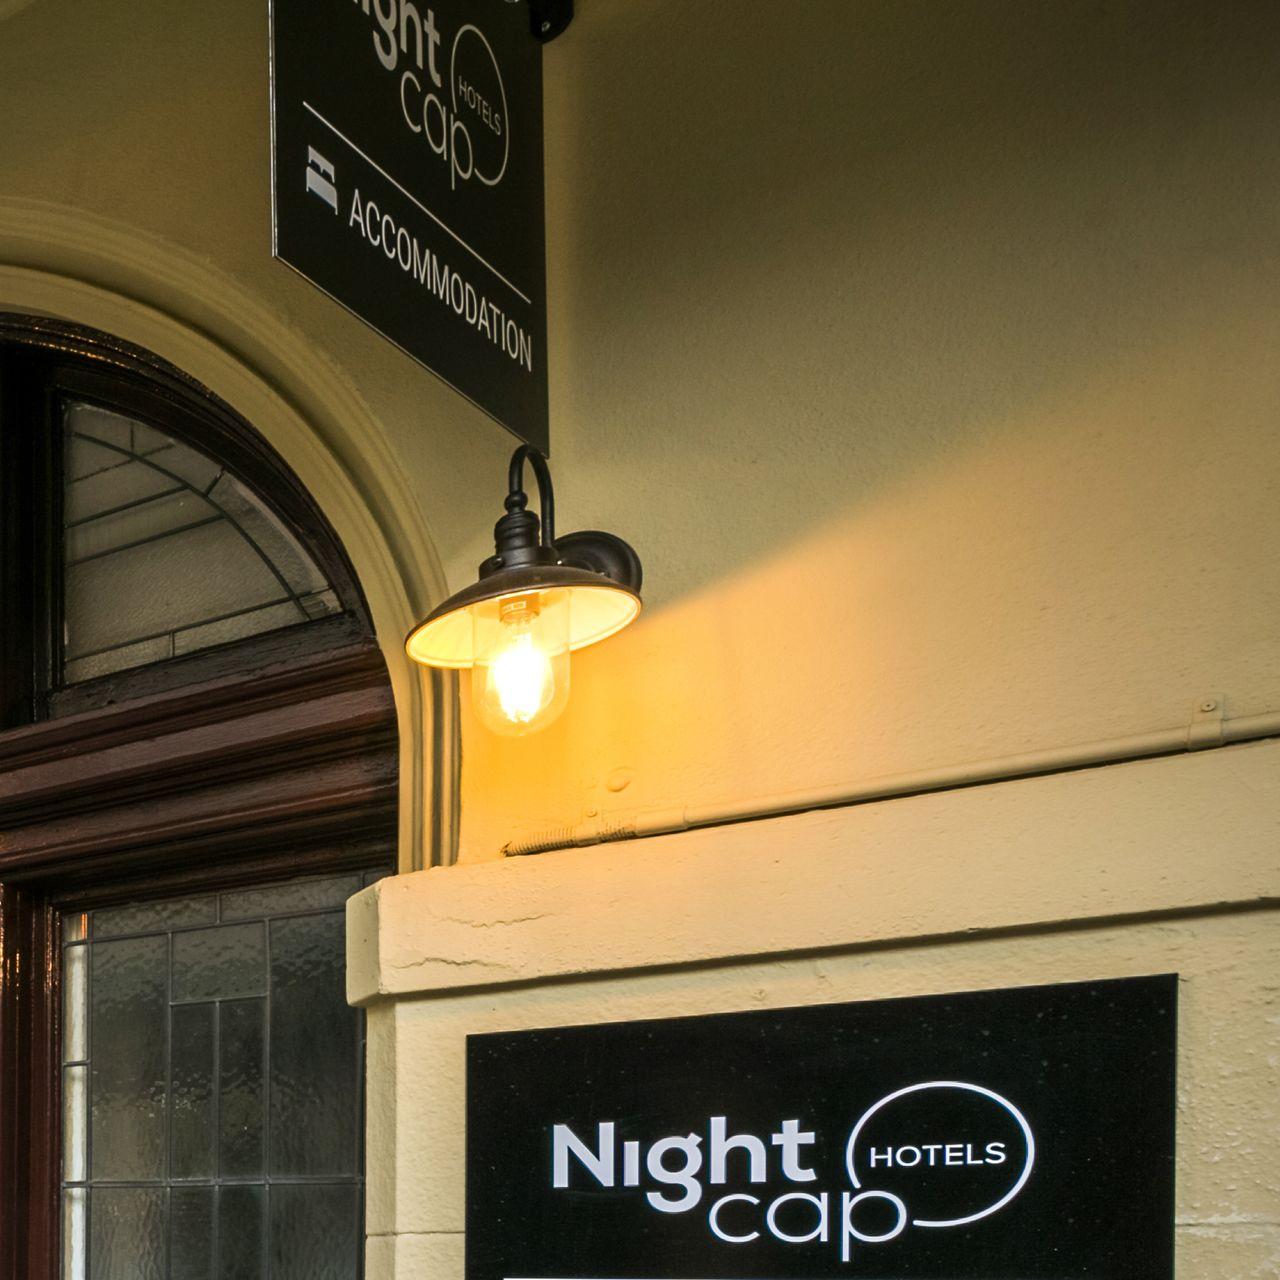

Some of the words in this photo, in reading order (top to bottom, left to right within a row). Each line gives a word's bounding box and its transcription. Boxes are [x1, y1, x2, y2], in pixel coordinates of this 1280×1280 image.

[354, 0, 441, 87] ght
[401, 70, 473, 190] cap
[458, 75, 501, 136] HOTELS
[348, 188, 533, 372] ACCOMMODATION
[553, 1116, 818, 1213] Night
[870, 1142, 1006, 1168] HOTELS
[708, 1190, 907, 1262] cap
